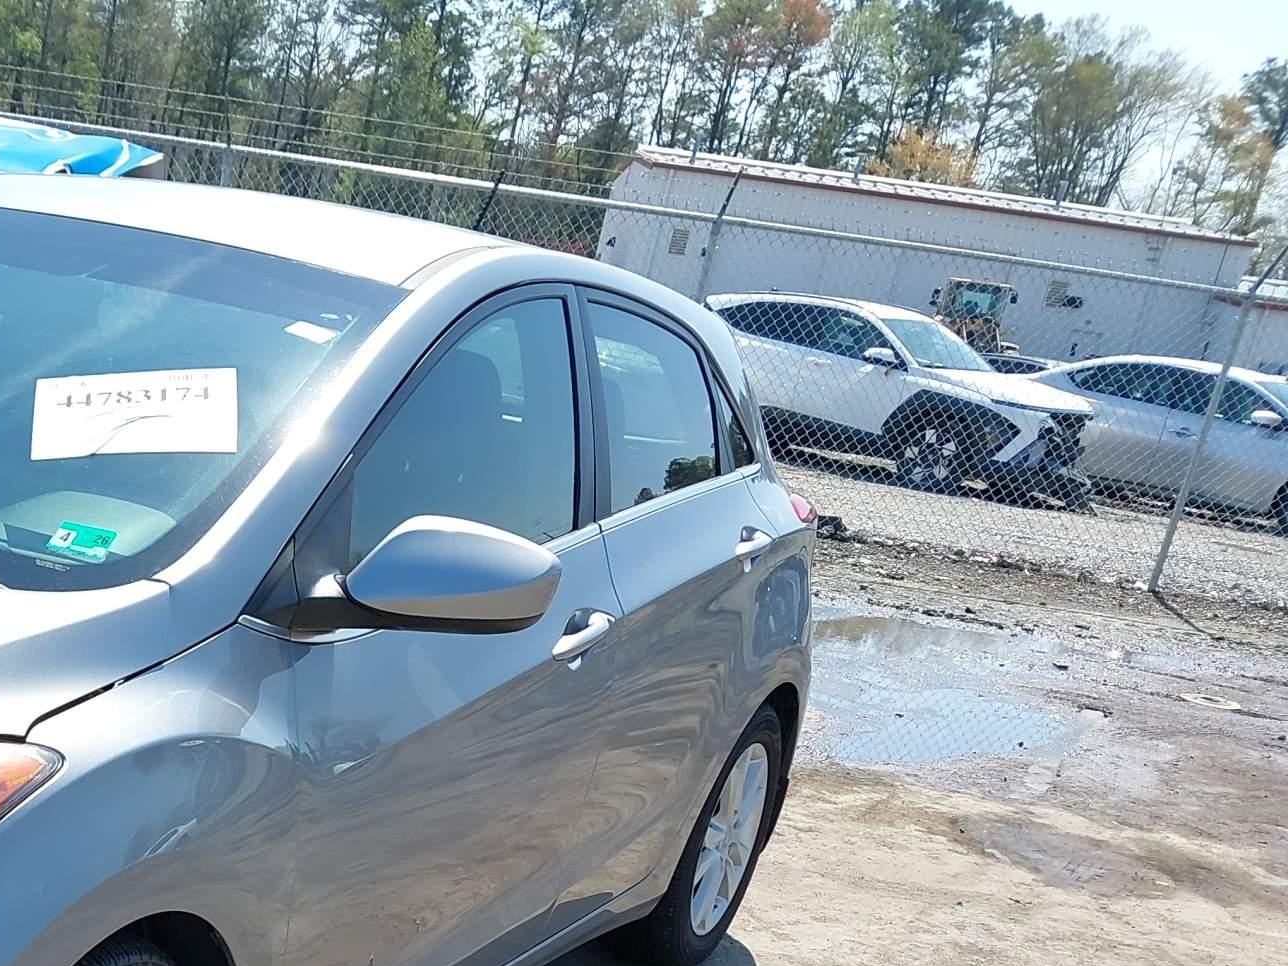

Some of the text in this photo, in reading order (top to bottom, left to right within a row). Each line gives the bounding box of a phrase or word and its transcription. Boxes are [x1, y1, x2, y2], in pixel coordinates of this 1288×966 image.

[56, 386, 210, 408] 44783174
[60, 532, 111, 546] 4 26
